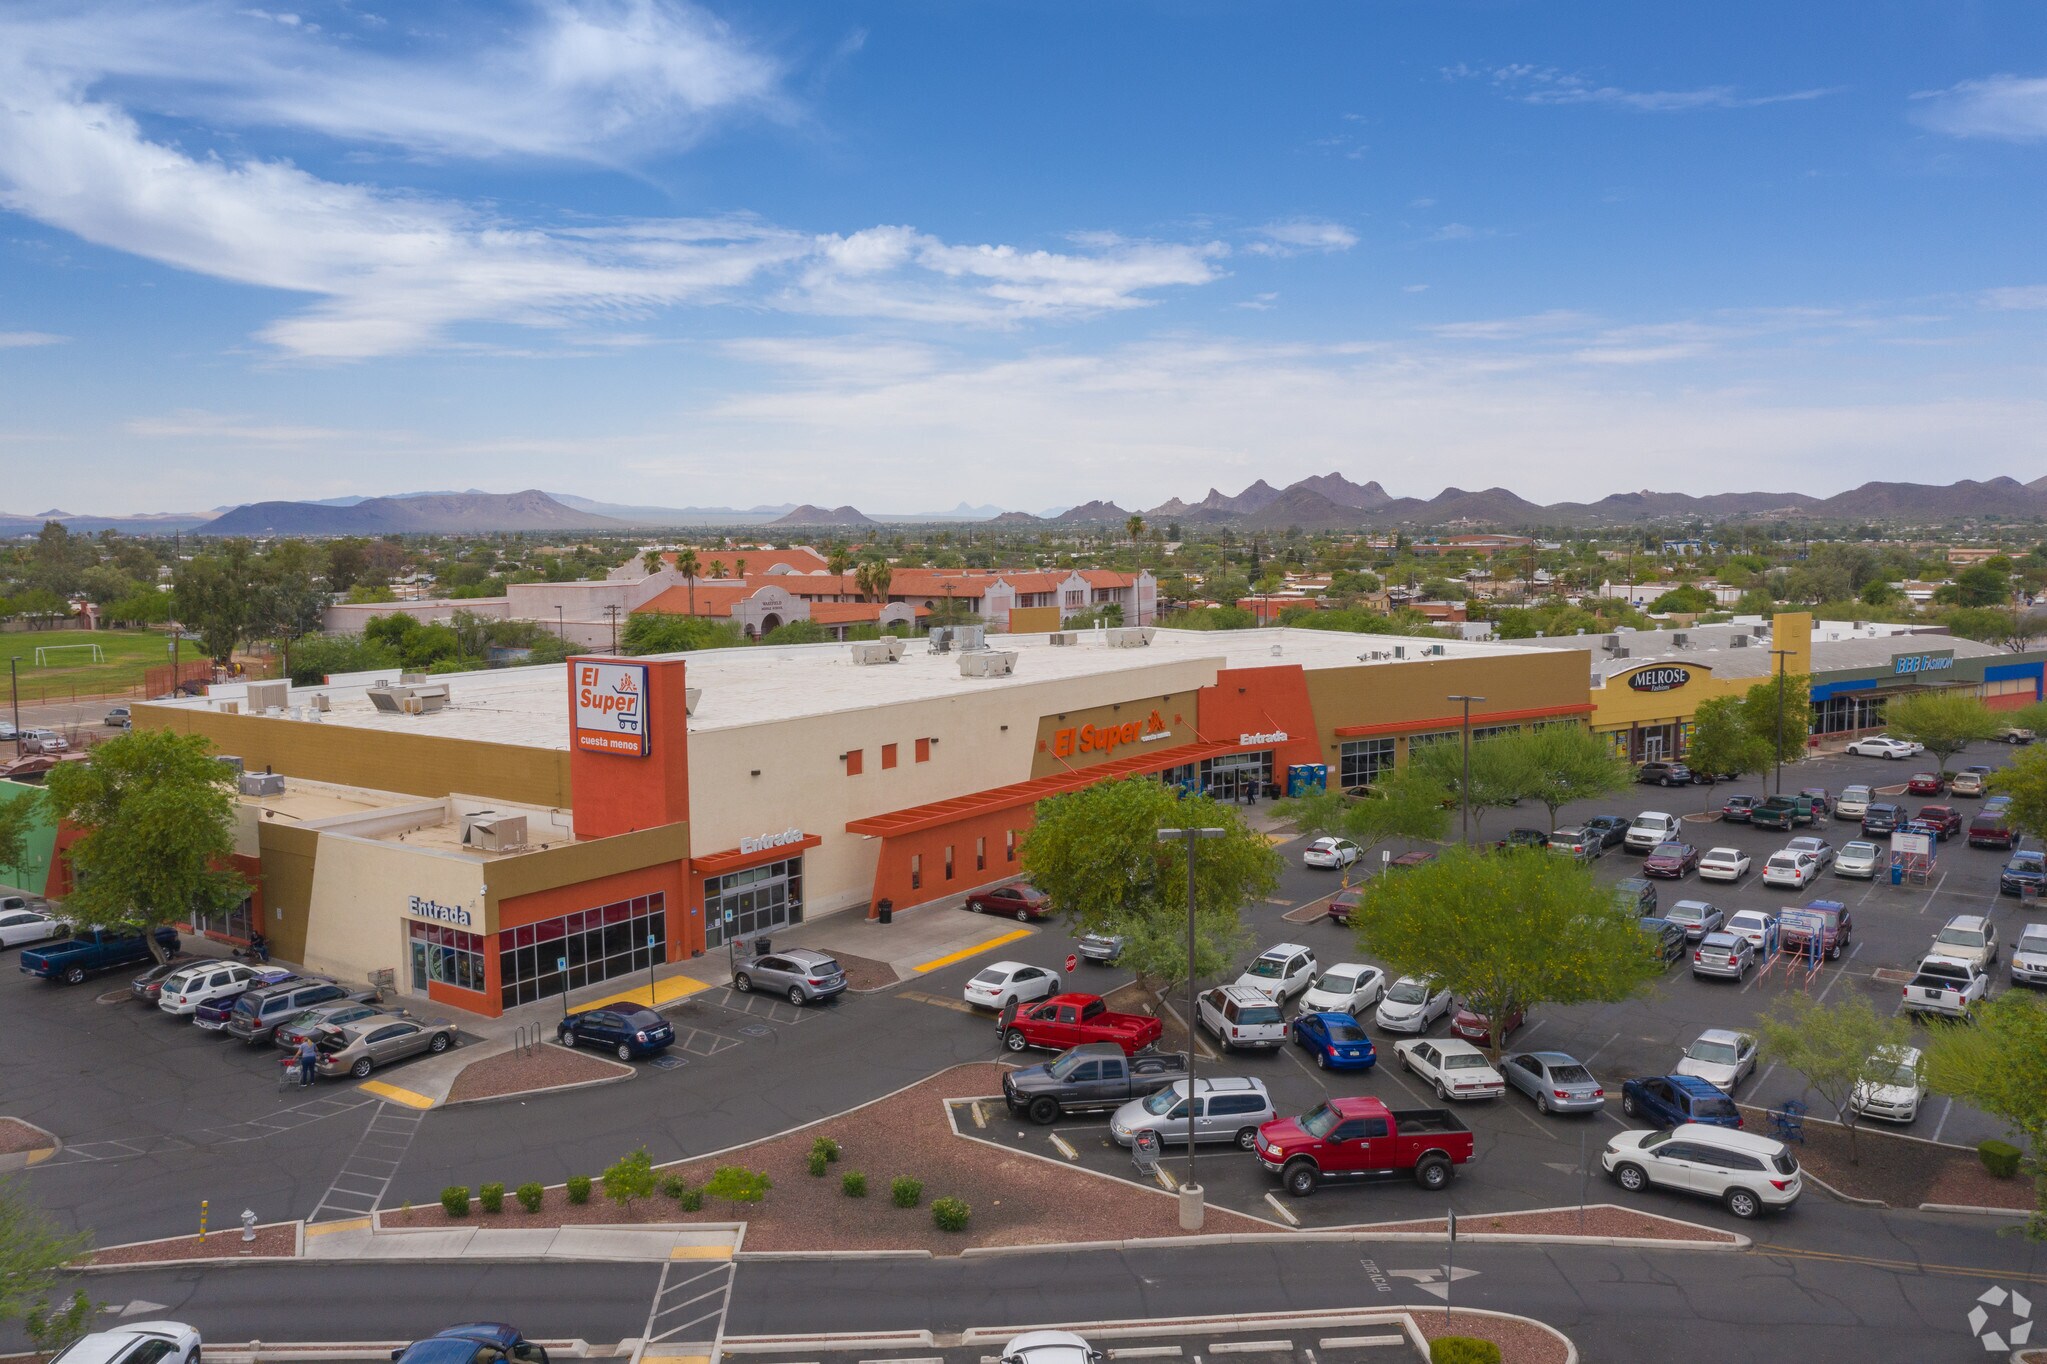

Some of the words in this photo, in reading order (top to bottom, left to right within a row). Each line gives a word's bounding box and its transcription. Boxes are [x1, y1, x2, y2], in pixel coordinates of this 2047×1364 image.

[1896, 656, 1920, 674] BBB
[581, 667, 599, 686] El
[1635, 669, 1685, 686] MELROSE
[580, 688, 635, 714] Super
[580, 735, 608, 747] cuesta
[610, 739, 638, 750] menos
[1054, 727, 1076, 758] El
[1080, 719, 1143, 754] Super
[1240, 730, 1288, 745] Entrada
[740, 827, 804, 854] Entrada
[408, 895, 471, 926] Entrada
[1066, 958, 1077, 968] STOP
[1360, 1259, 1392, 1291] CURACAO
